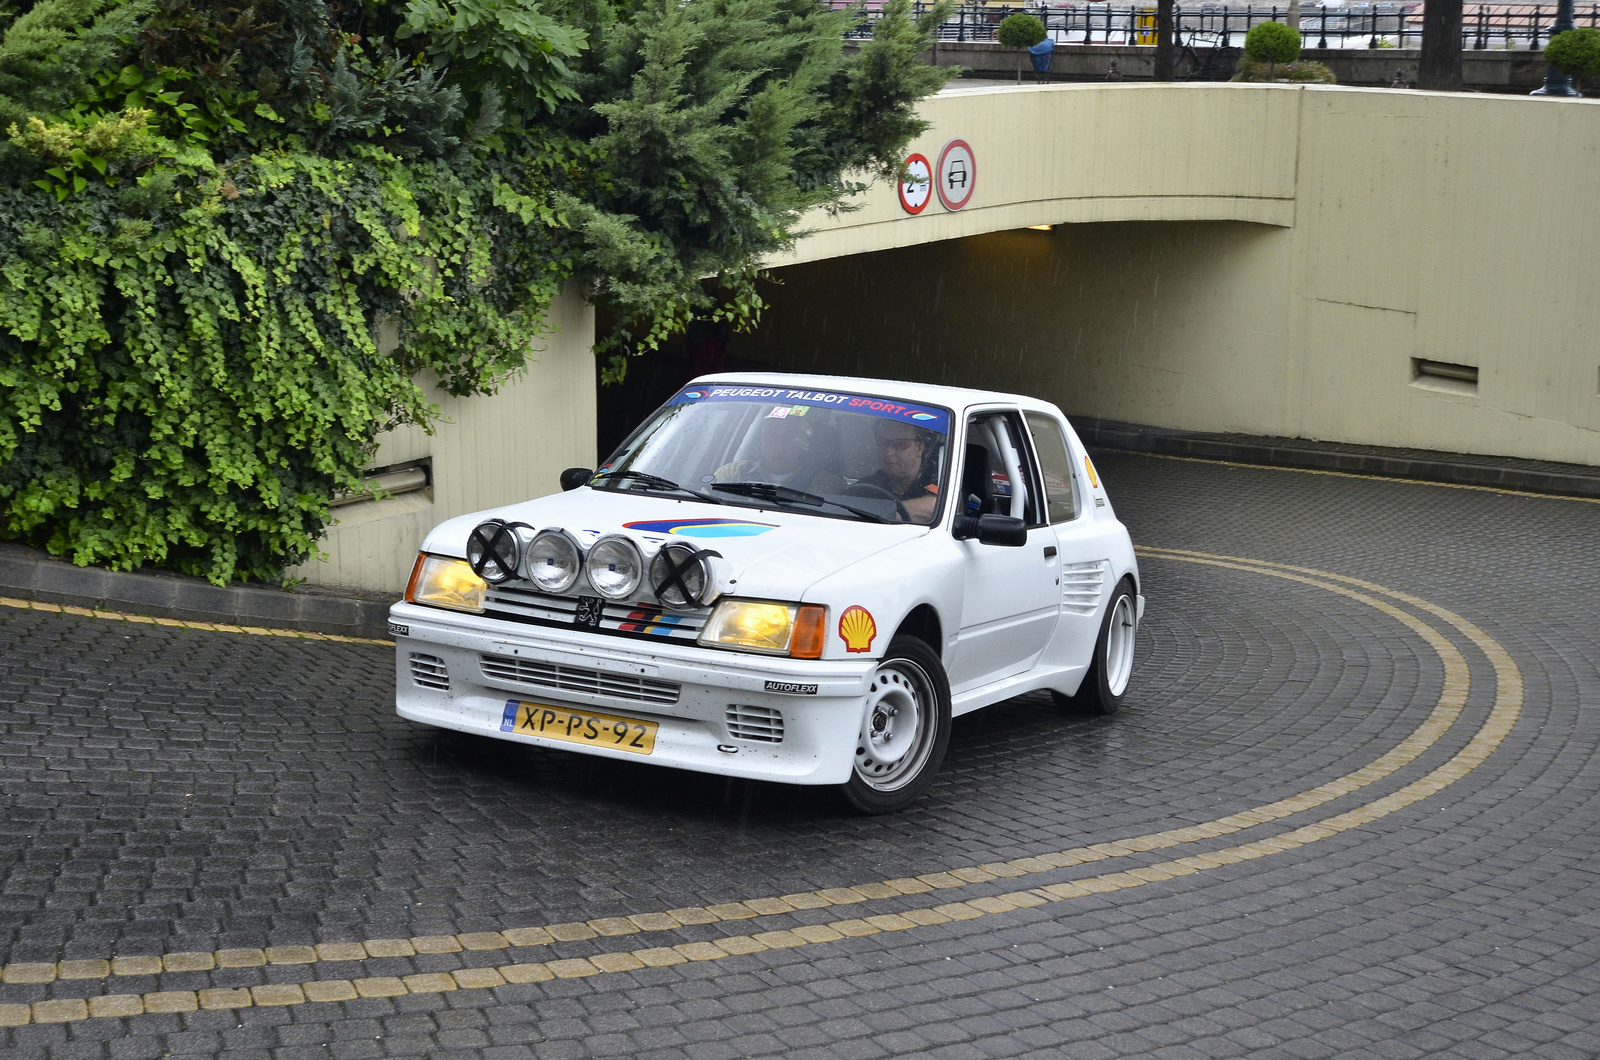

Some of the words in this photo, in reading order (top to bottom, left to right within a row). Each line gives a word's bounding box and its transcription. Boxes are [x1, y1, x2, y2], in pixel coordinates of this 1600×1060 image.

[709, 387, 785, 398] PEUGEOT
[785, 389, 849, 406] TALBOT
[848, 397, 906, 415] SPORT
[766, 682, 817, 693] AUTOFLEXX
[503, 718, 514, 728] NL
[520, 706, 647, 748] XP-PS-92
